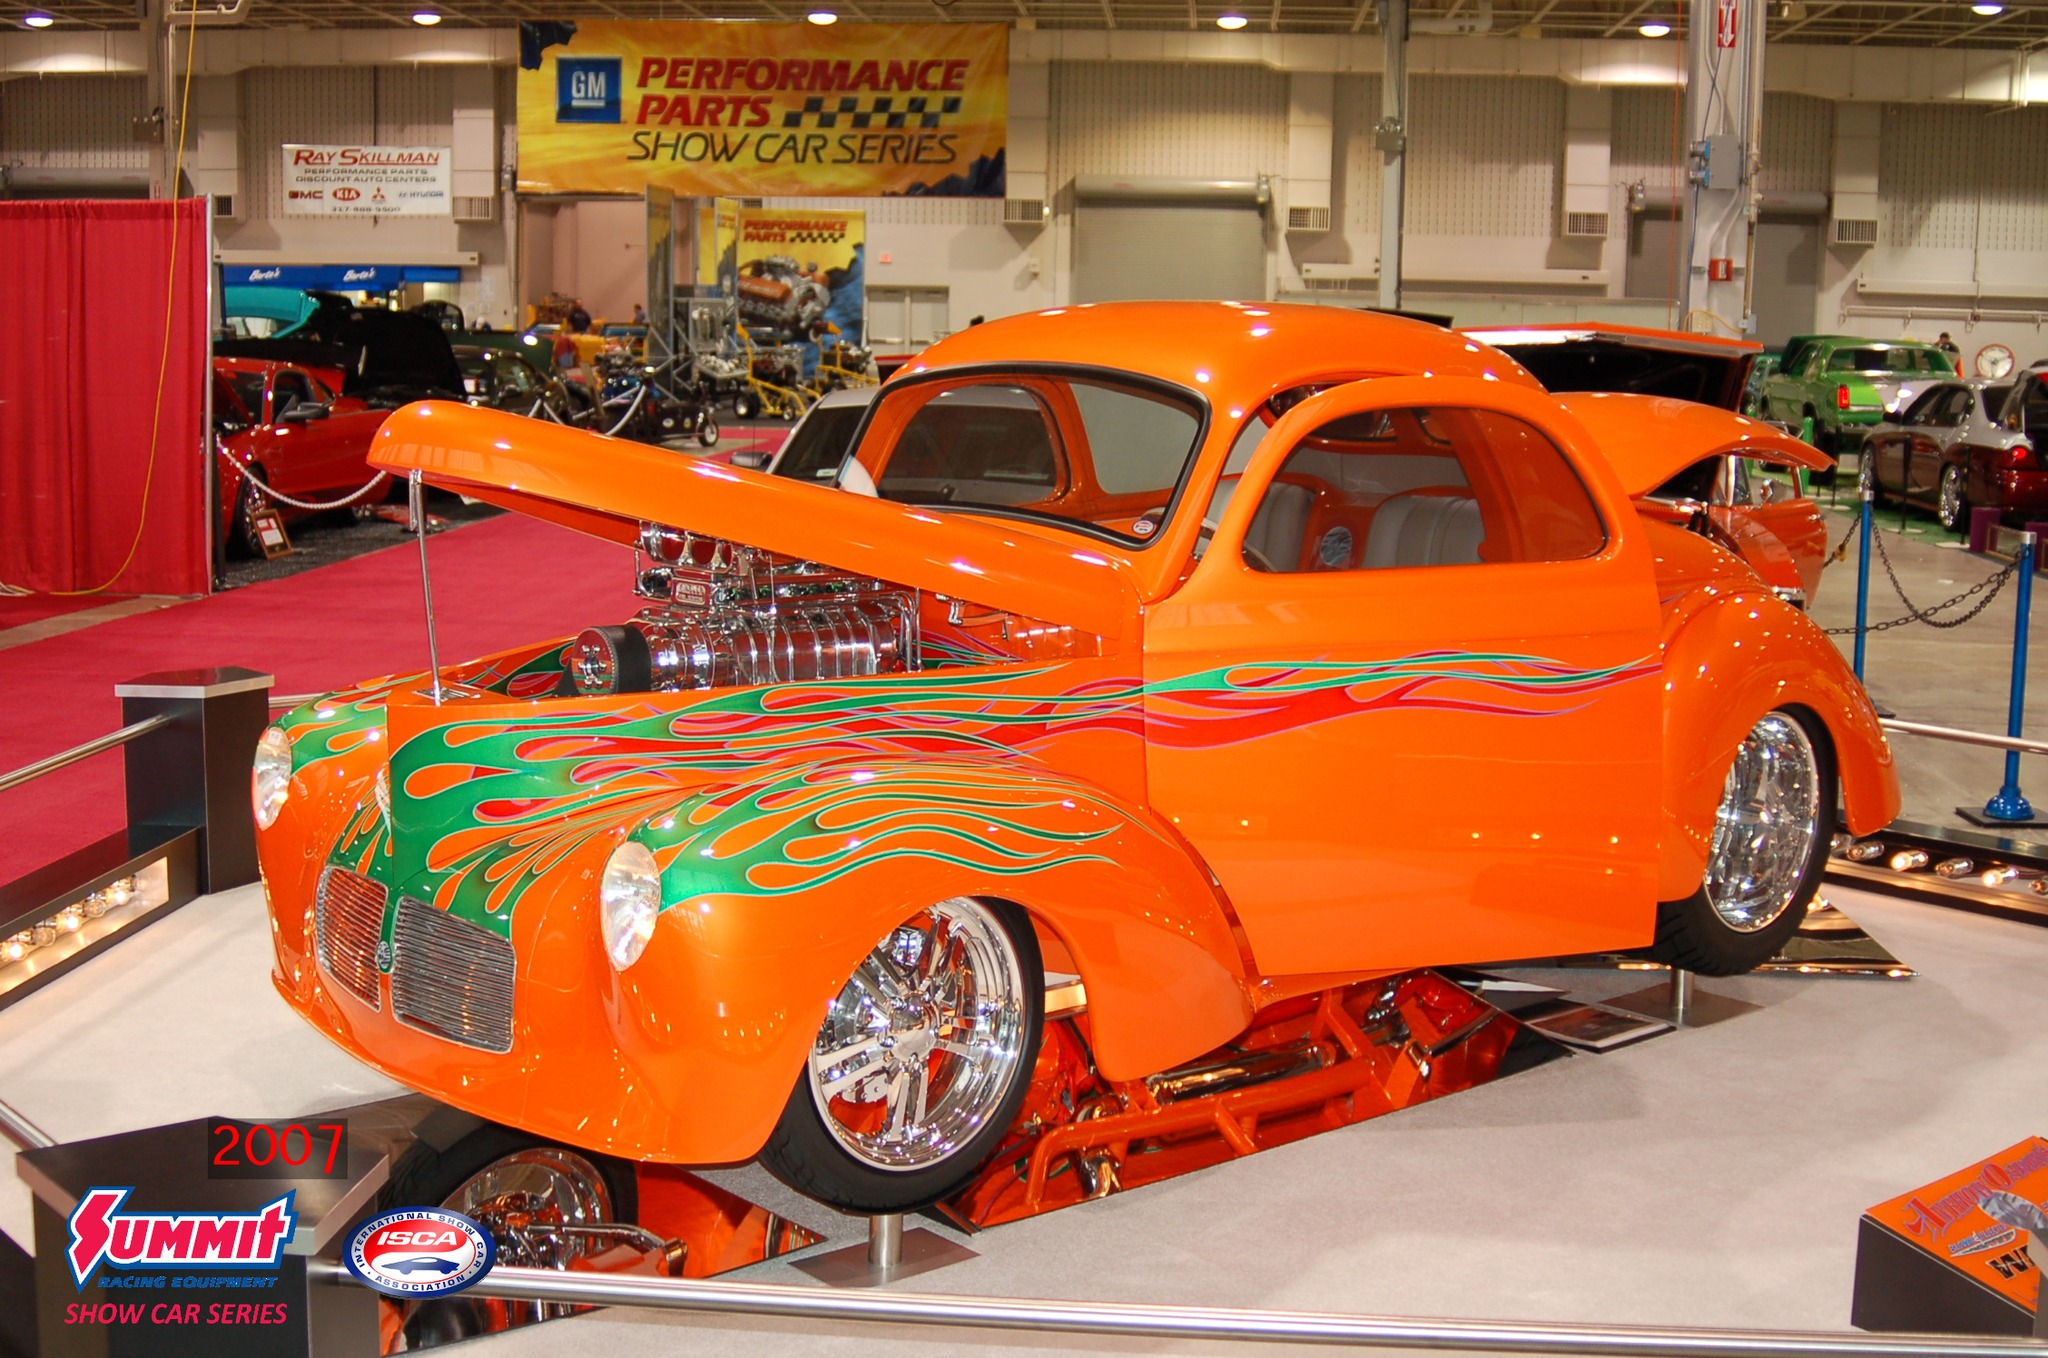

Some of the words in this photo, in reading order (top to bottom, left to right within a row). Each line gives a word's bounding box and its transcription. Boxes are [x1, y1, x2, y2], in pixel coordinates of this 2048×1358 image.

[636, 57, 970, 91] PERFORMANCE
[571, 71, 606, 98] GM
[636, 94, 773, 126] PARTS
[627, 131, 749, 161] SHOW
[754, 133, 828, 163] CAR
[832, 133, 958, 164] SERIES
[293, 149, 337, 166] RAY
[338, 148, 440, 166] SKILLMAN
[295, 175, 351, 183] DISCOUNT
[334, 188, 359, 200] KIA
[744, 219, 848, 232] PERFORMANCE
[743, 231, 787, 243] PARTS
